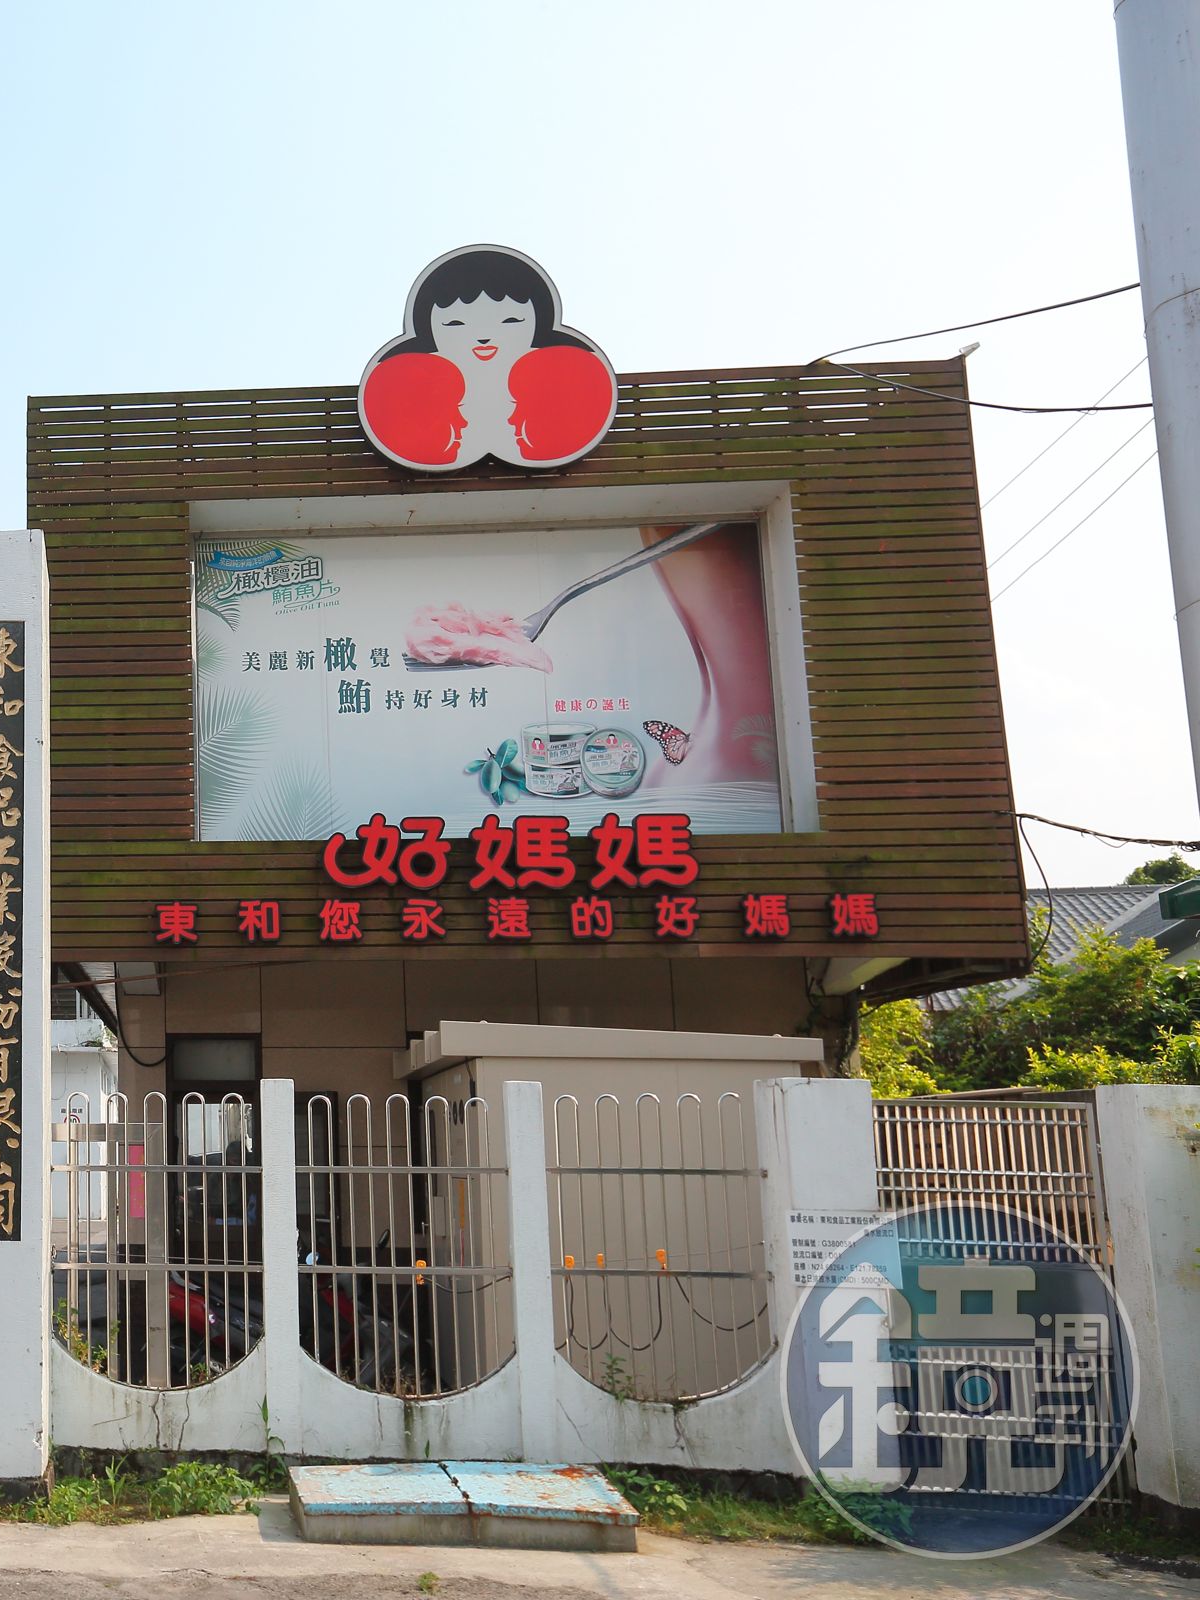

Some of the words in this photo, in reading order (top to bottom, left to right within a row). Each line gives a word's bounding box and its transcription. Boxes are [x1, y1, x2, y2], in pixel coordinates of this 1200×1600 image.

[234, 559, 320, 591] 橄欖油
[272, 579, 340, 607] 鮪魚片
[241, 636, 391, 673] 美麗新橄覺
[337, 679, 489, 715] 鮪持好身材
[555, 698, 630, 712] 健康の誕生
[323, 811, 700, 890] 好媽媽
[154, 892, 880, 945] 東和您永遠的好媽媽
